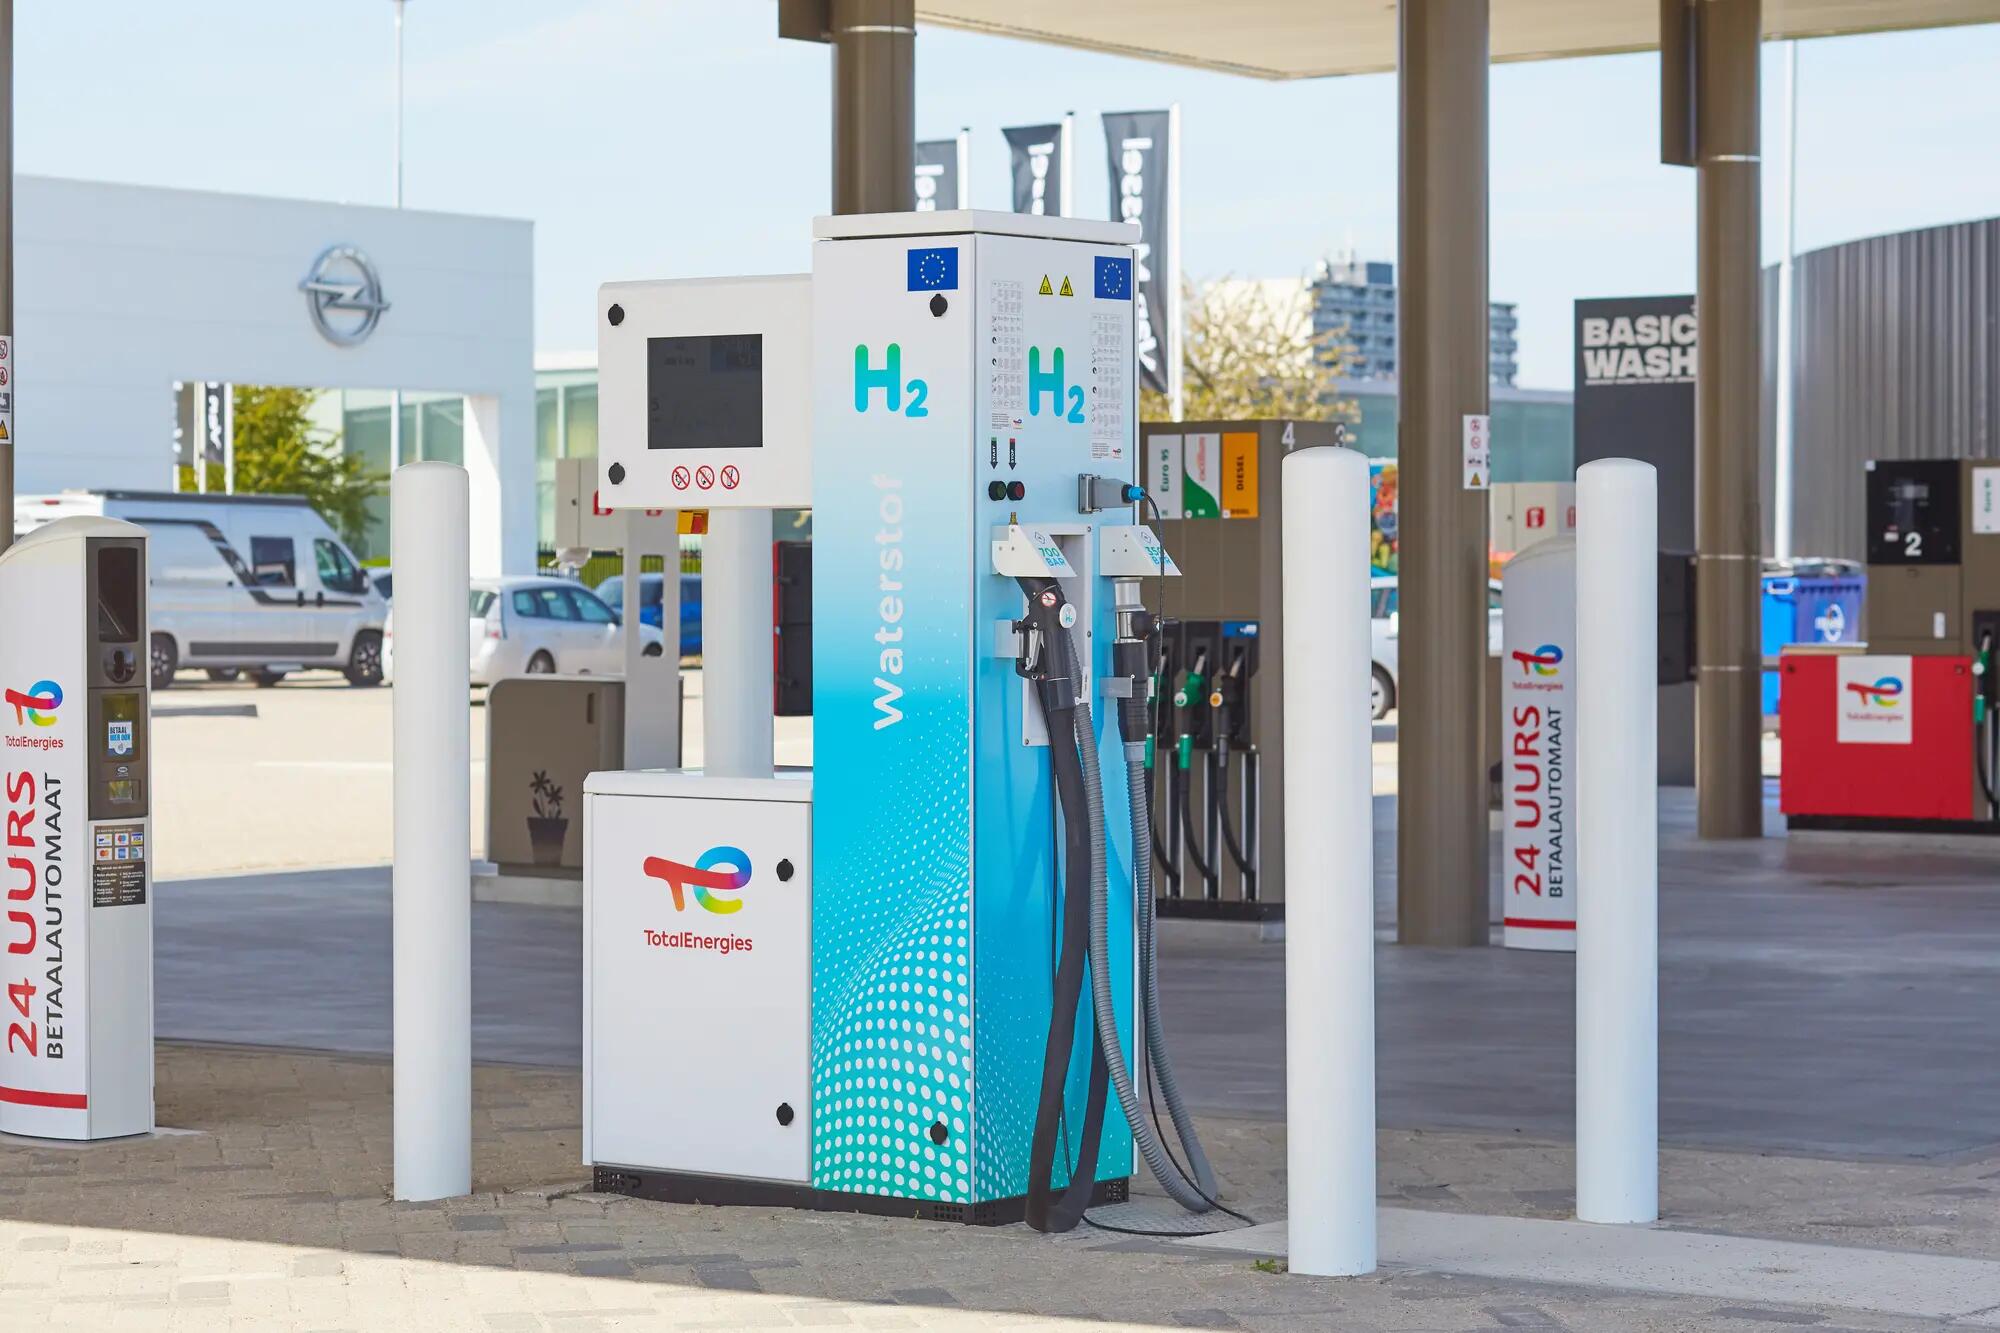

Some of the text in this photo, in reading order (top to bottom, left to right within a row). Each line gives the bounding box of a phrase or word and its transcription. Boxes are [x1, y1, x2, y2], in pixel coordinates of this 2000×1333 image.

[1582, 313, 1698, 347] BASIC
[1582, 345, 1698, 379] WASH
[854, 342, 929, 418] H2
[1028, 345, 1085, 424] H2
[1281, 421, 1296, 450] 4
[1235, 455, 1245, 491] DIESEL
[1038, 547, 1060, 558] 700
[1904, 531, 1922, 556] 2
[1045, 557, 1067, 567] BAR
[872, 473, 904, 731] Waterstof
[5, 735, 64, 751] TotalEnergies
[1513, 705, 1541, 897] 24 UURS
[1547, 706, 1563, 898] BETAALAUTOMAAT
[6, 771, 37, 1057] 24 UURS
[44, 772, 63, 1059] BETAALAUTOMAAT
[643, 928, 753, 955] TotalEnergies
